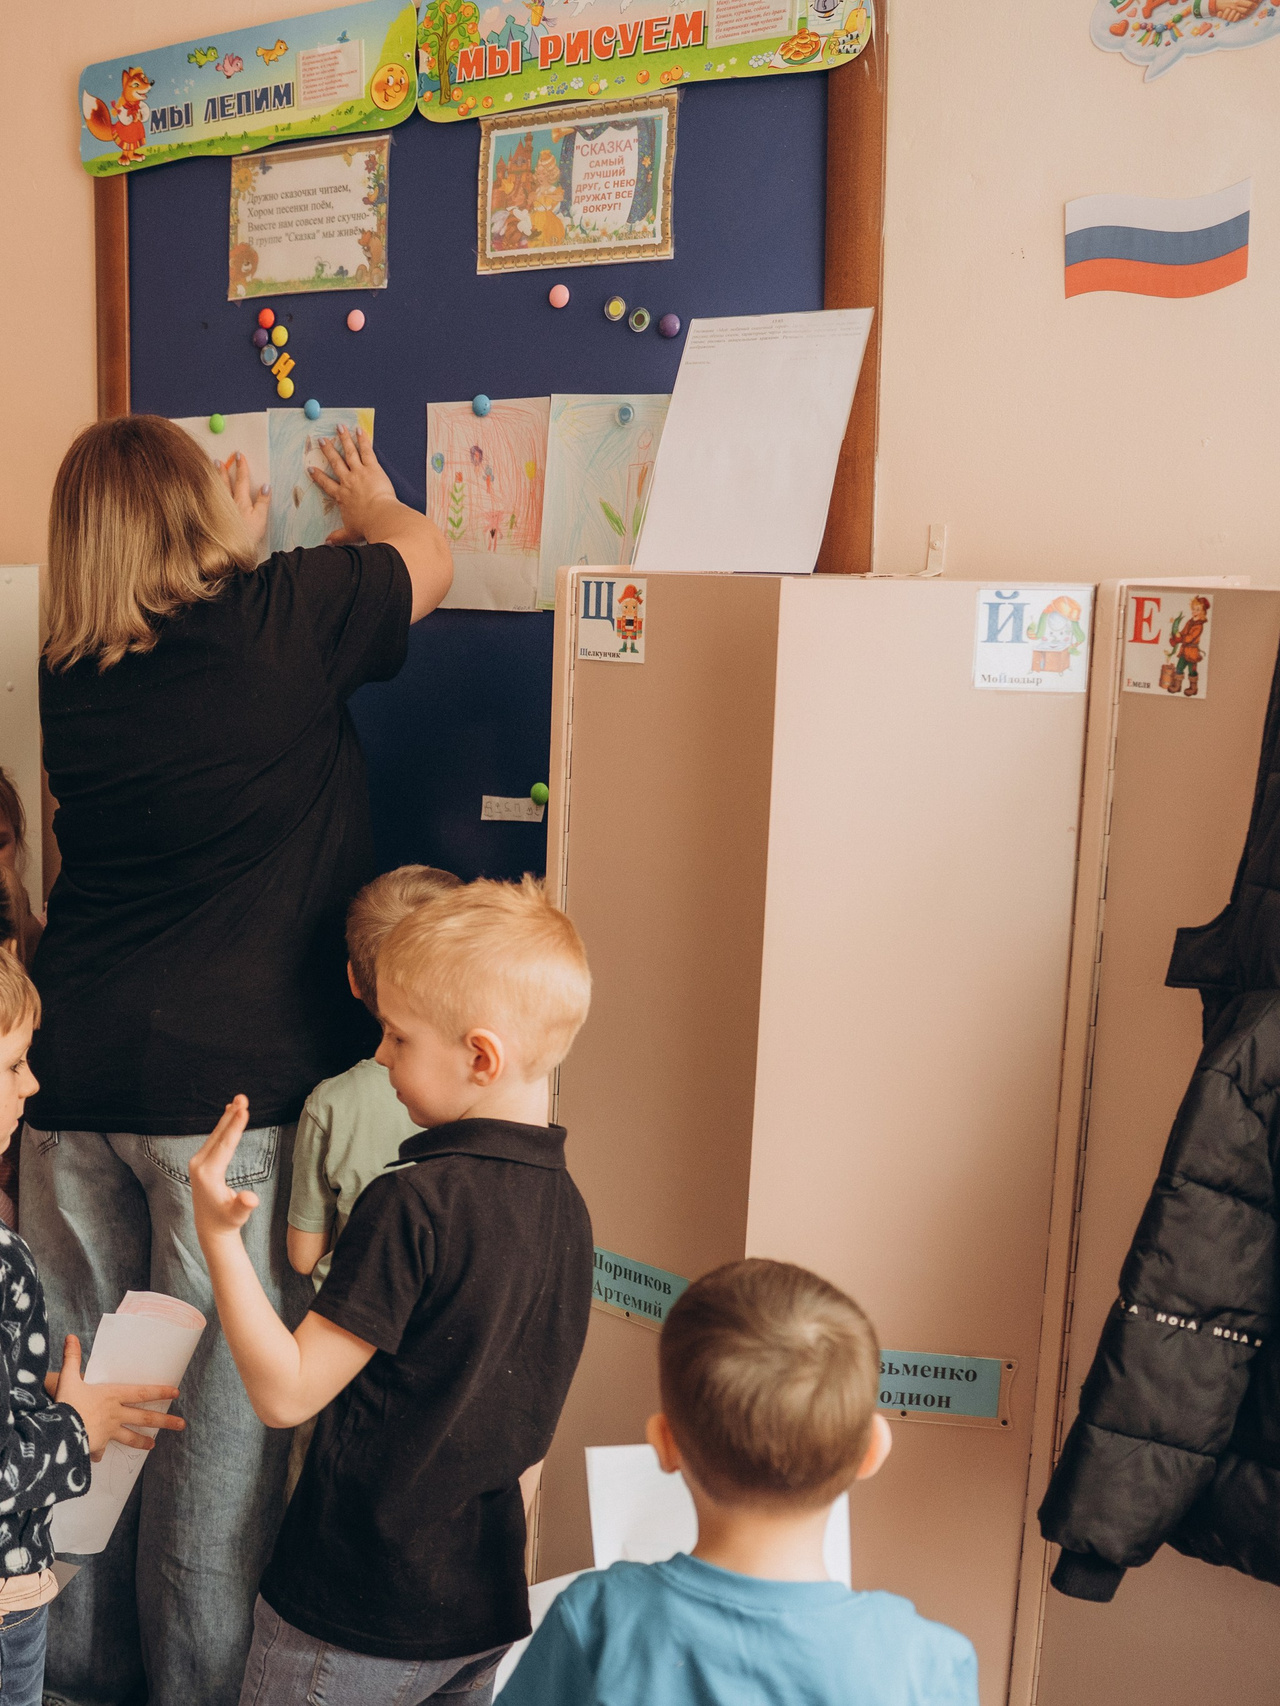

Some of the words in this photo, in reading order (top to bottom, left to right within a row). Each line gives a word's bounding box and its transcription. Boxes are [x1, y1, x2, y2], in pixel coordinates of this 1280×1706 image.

[456, 39, 523, 84] МЫ
[538, 9, 705, 70] РИСУЕМ
[149, 101, 193, 134] МЫ
[203, 81, 294, 123] ЛЕПИМ
[576, 139, 638, 157] "СКАЗКА"
[589, 155, 624, 168] САМЫЙ
[583, 167, 626, 180] ЛУЧШИЙ
[247, 192, 278, 205] Дружно
[280, 188, 317, 199] сказочки
[319, 184, 351, 194] читаем,
[575, 182, 601, 193] ДРУГ,
[604, 181, 610, 189] С
[613, 179, 636, 188] НЕЮ
[573, 192, 612, 205] ДРУЖАТ
[615, 190, 633, 200] ВСЕ
[247, 208, 274, 219] Хором
[276, 202, 309, 213] песенки
[311, 200, 334, 211] поём,
[582, 202, 622, 214] ВОКРУГ!
[247, 221, 276, 232] Вместе
[278, 220, 293, 229] нам
[295, 217, 324, 227] совсем
[326, 215, 335, 223] не
[248, 236, 255, 246] В
[255, 235, 282, 248] группе
[285, 229, 320, 242] "Сказка"
[322, 230, 335, 239] мы
[581, 581, 616, 631] Щ
[980, 590, 1031, 644] Й
[1128, 596, 1161, 644] Е
[580, 648, 621, 659] Щелкунчик
[1127, 678, 1151, 689] Емеля
[592, 1279, 662, 1318] Артемий
[1156, 1313, 1197, 1331] HOLA
[1213, 1326, 1249, 1344] HOLA
[879, 1361, 977, 1382] зьменко
[880, 1390, 951, 1409] одион
